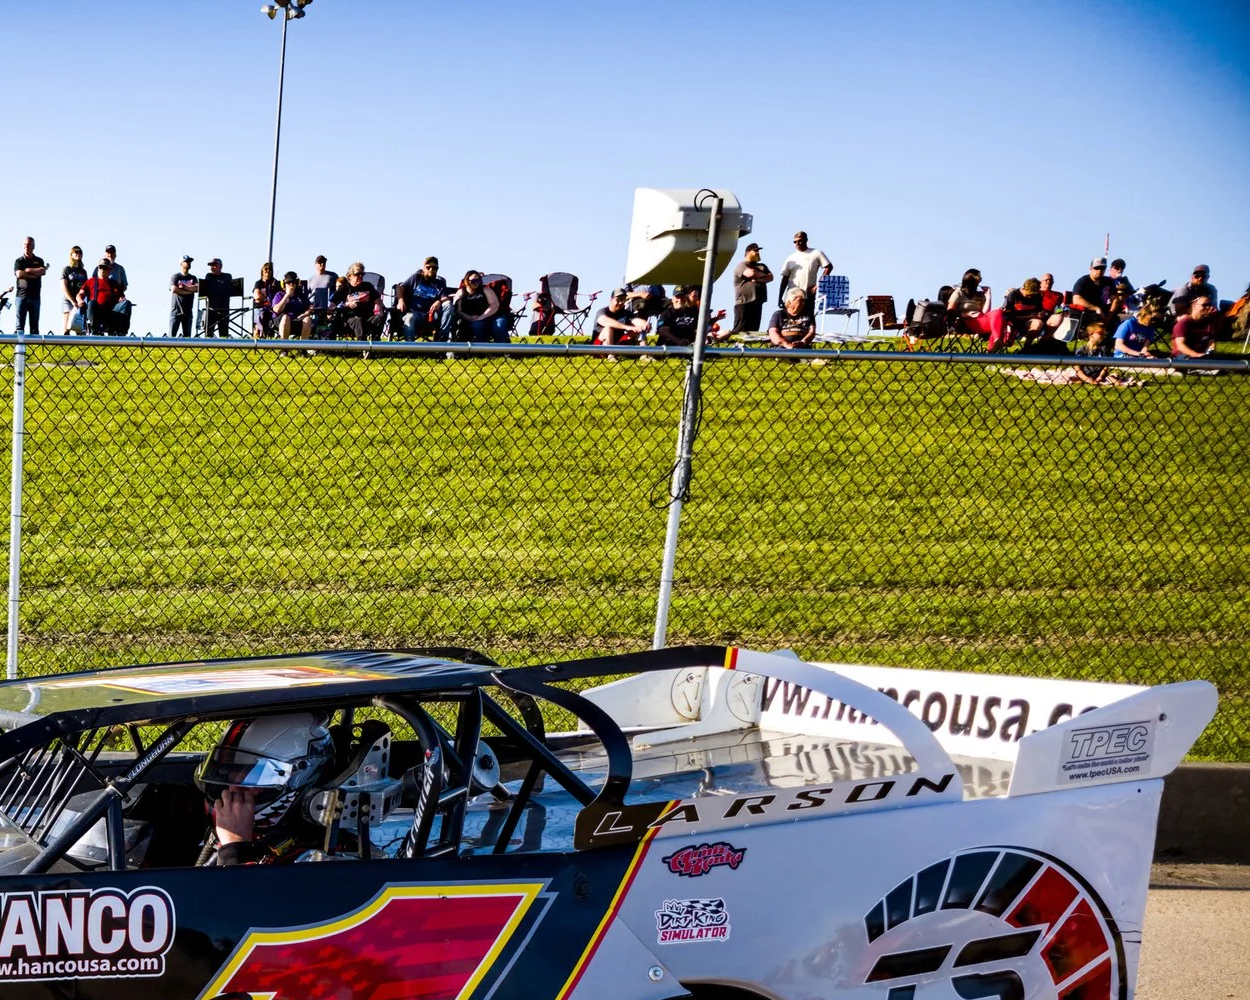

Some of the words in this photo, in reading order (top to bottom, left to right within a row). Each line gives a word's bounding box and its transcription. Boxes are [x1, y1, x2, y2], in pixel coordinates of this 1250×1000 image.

[130, 733, 174, 776] LONGHORN
[1071, 726, 1148, 759] TPEC
[1069, 765, 1140, 780] www.tpecUSA.com
[593, 774, 954, 835] LARSON
[660, 926, 727, 941] SIMULATOR
